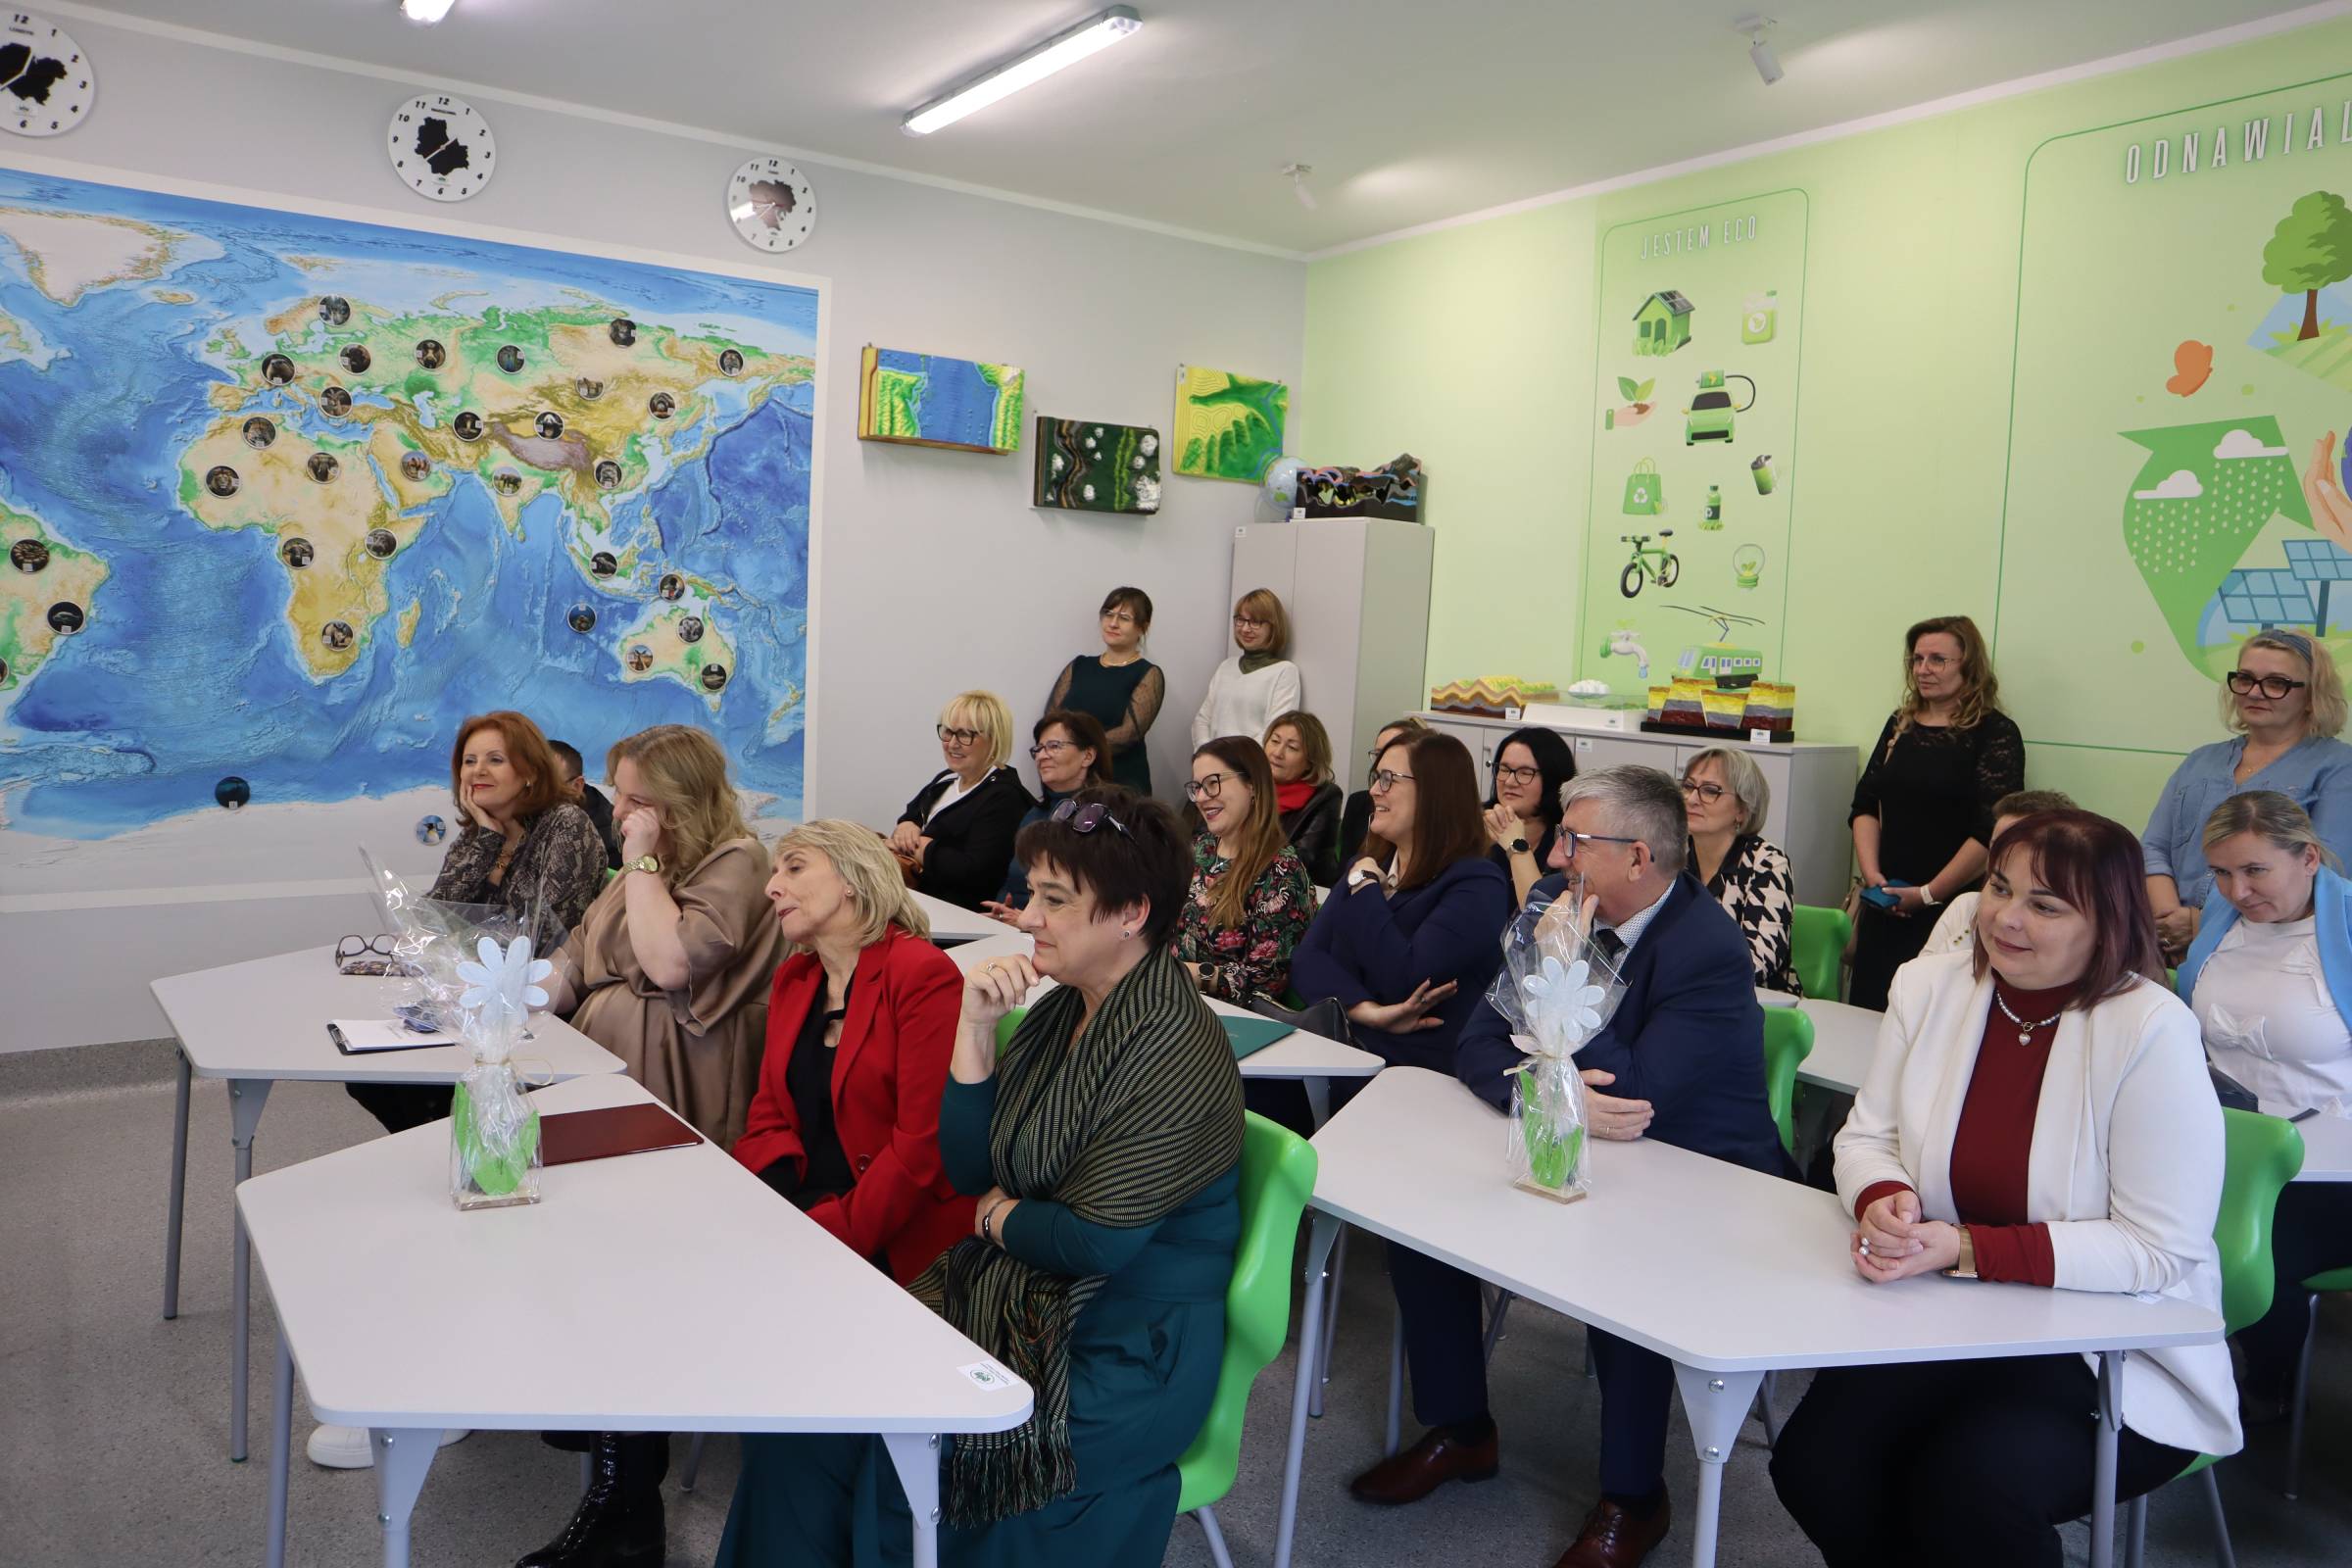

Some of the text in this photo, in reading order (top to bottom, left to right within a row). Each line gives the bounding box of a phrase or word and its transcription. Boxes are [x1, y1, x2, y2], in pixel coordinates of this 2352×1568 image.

[15, 14, 29, 24] 12
[51, 28, 57, 37] 1
[71, 54, 79, 63] 2
[79, 80, 87, 89] 3
[398, 114, 410, 122] 10
[20, 120, 27, 128] 6
[1641, 215, 1756, 260] JESTEM ECO
